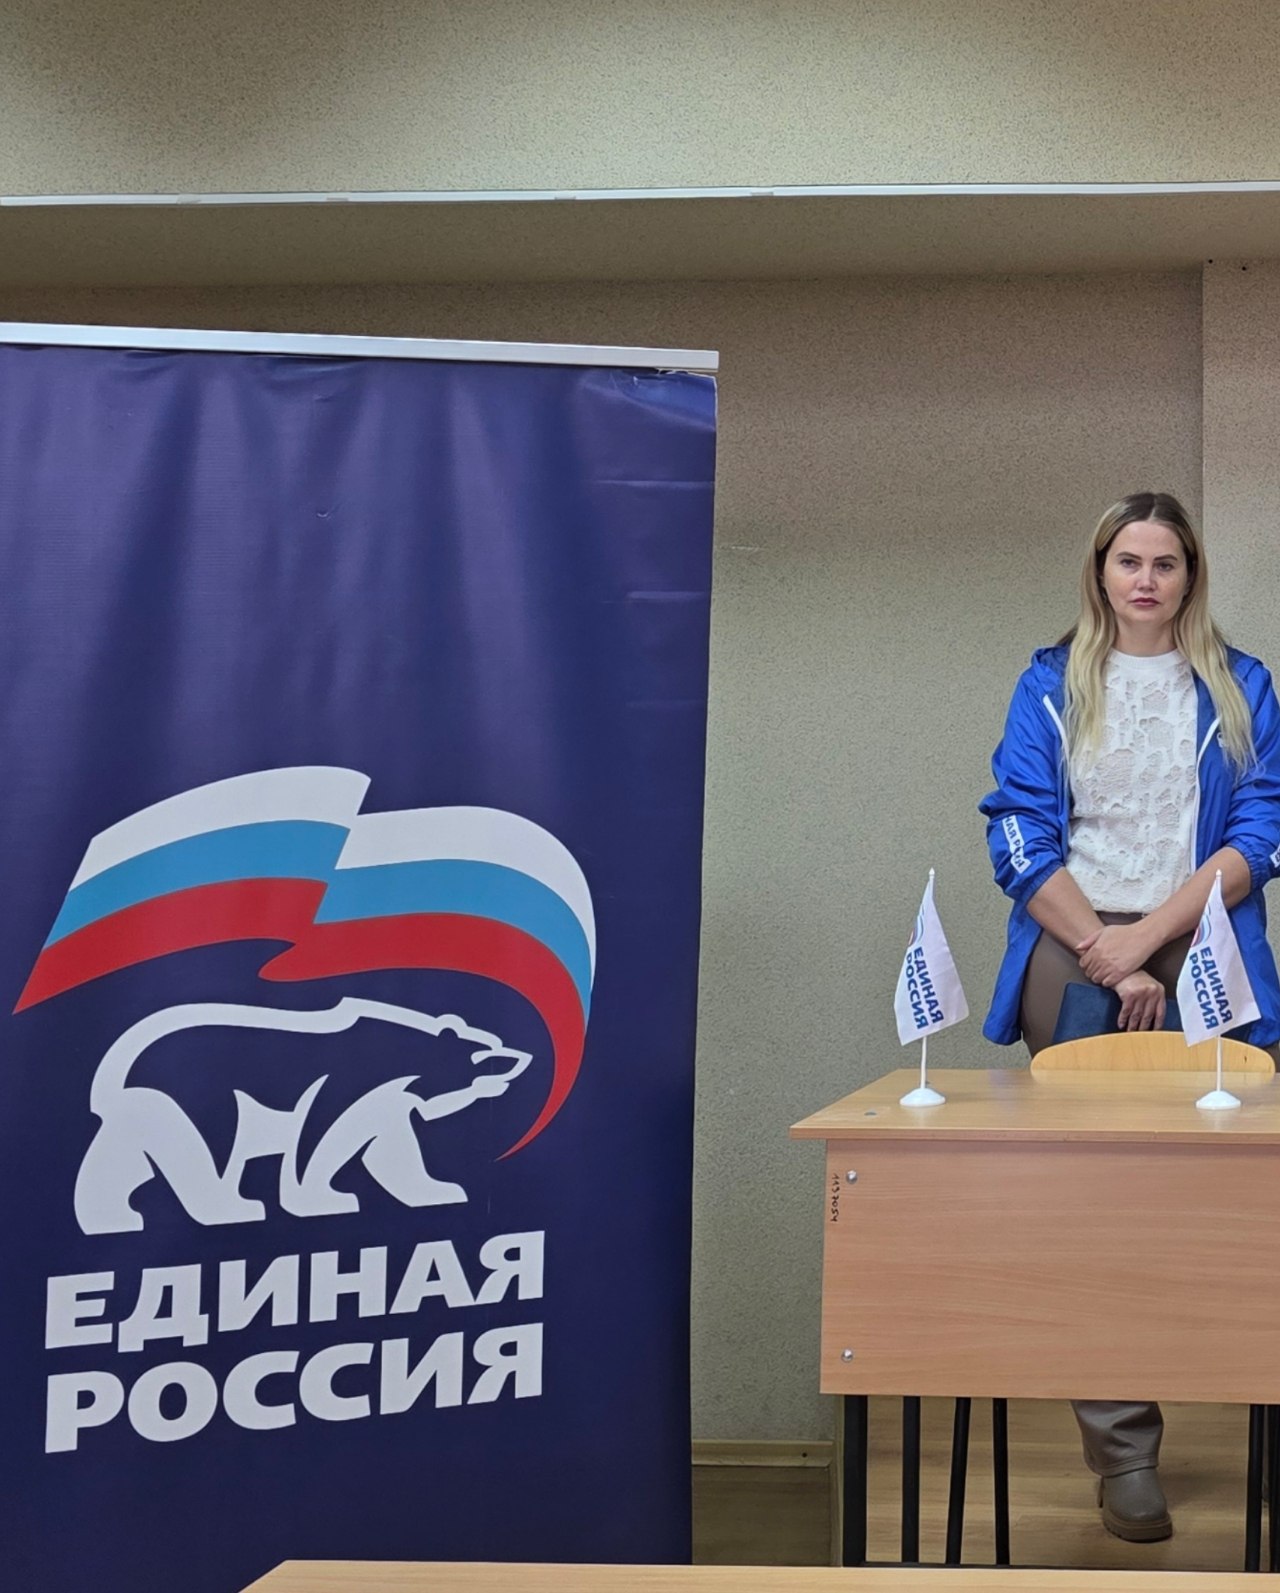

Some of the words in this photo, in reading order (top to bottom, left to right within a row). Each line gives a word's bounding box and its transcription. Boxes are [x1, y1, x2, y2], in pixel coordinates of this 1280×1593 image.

[913, 946, 944, 1023] ЕДИНАЯ
[1189, 951, 1220, 1030] РОССИЯ
[1200, 946, 1233, 1024] ЕДИНАЯ
[45, 1230, 545, 1353] ЕДИНАЯ
[45, 1322, 544, 1454] РОССИЯ
